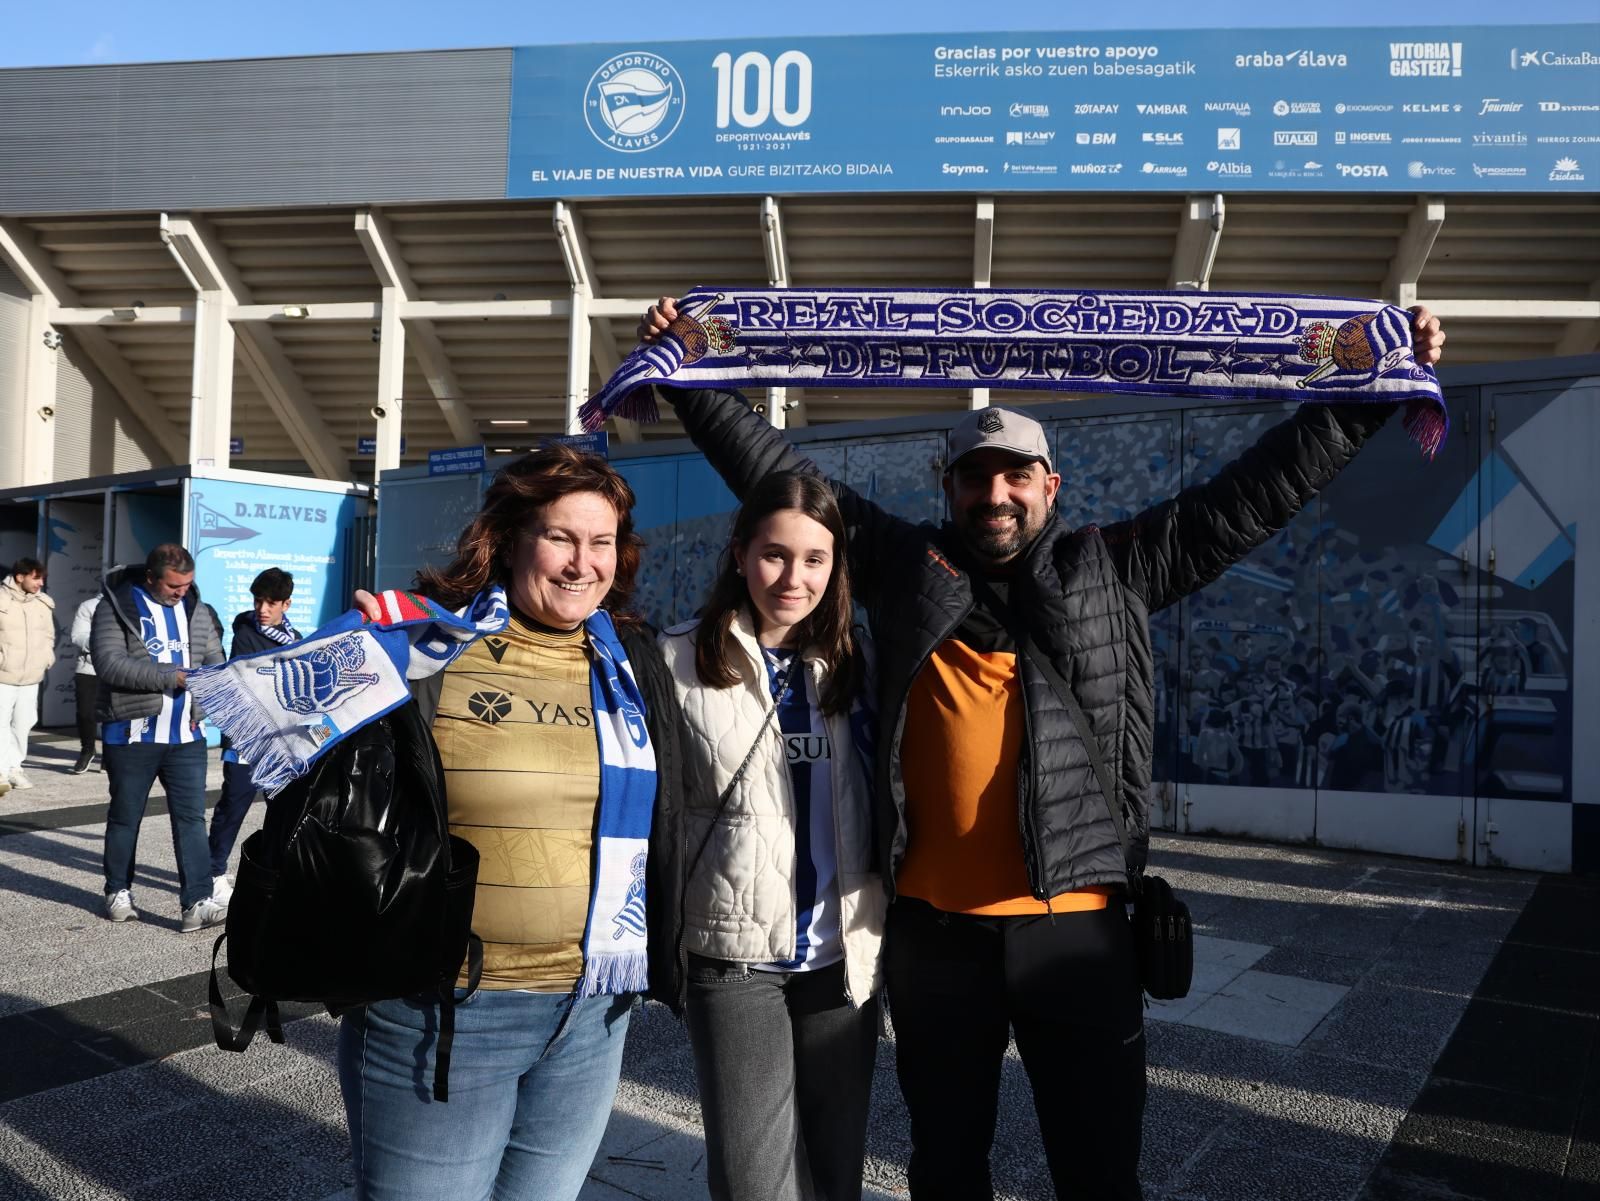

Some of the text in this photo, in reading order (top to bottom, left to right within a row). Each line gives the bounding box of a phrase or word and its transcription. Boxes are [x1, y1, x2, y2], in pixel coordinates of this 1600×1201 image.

[935, 45, 1158, 61] Gracias por vuestro apoyo
[1235, 50, 1348, 67] araba álava
[1390, 43, 1450, 59] VITORIA
[601, 56, 670, 79] DEPORTIVO
[935, 61, 1195, 77] Eskerrik asko zuen babesagatik
[1390, 60, 1450, 76] GASTEIZ
[711, 50, 812, 128] 100
[1145, 104, 1187, 114] AMBAR
[1402, 104, 1450, 112] KELME
[1479, 99, 1523, 115] Fournier
[608, 132, 659, 148] ALAVÉS
[1092, 132, 1117, 145] BM
[1155, 133, 1183, 141] SLK
[1278, 134, 1314, 145] VIALKI
[1350, 132, 1392, 141] INGEVEL
[1473, 132, 1527, 142] vivantis
[532, 164, 893, 181] EL VIAJE DE NUESTRA VIDA GURE BIZITZAKO BIDAIA
[1071, 164, 1106, 174] MUÑOZ
[1154, 166, 1188, 174] ARRIAGA
[1218, 163, 1251, 174] Albia
[733, 296, 911, 332] REAL
[825, 340, 1193, 383] DE FUTBOL
[526, 700, 594, 727] YAS
